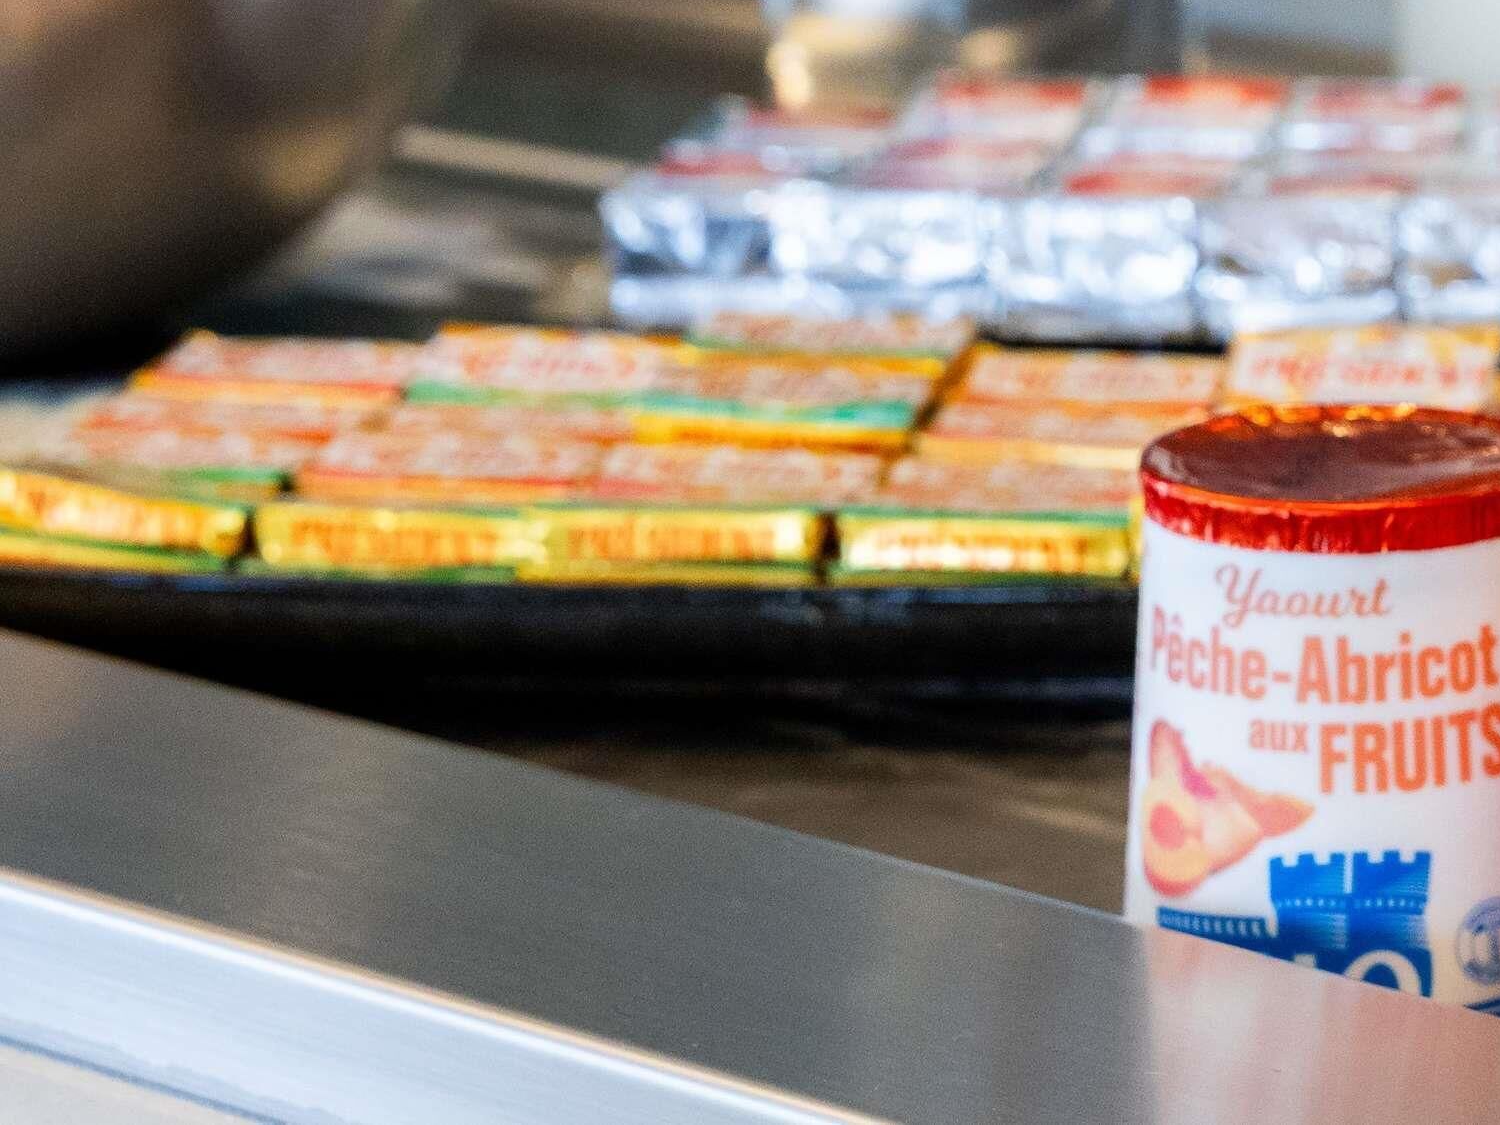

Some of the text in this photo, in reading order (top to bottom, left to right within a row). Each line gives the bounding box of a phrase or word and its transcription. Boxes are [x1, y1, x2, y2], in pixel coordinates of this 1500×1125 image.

[1216, 563, 1394, 627] Yaourt
[1151, 603, 1499, 704] Pêche-Abricot
[1249, 719, 1309, 753] aux
